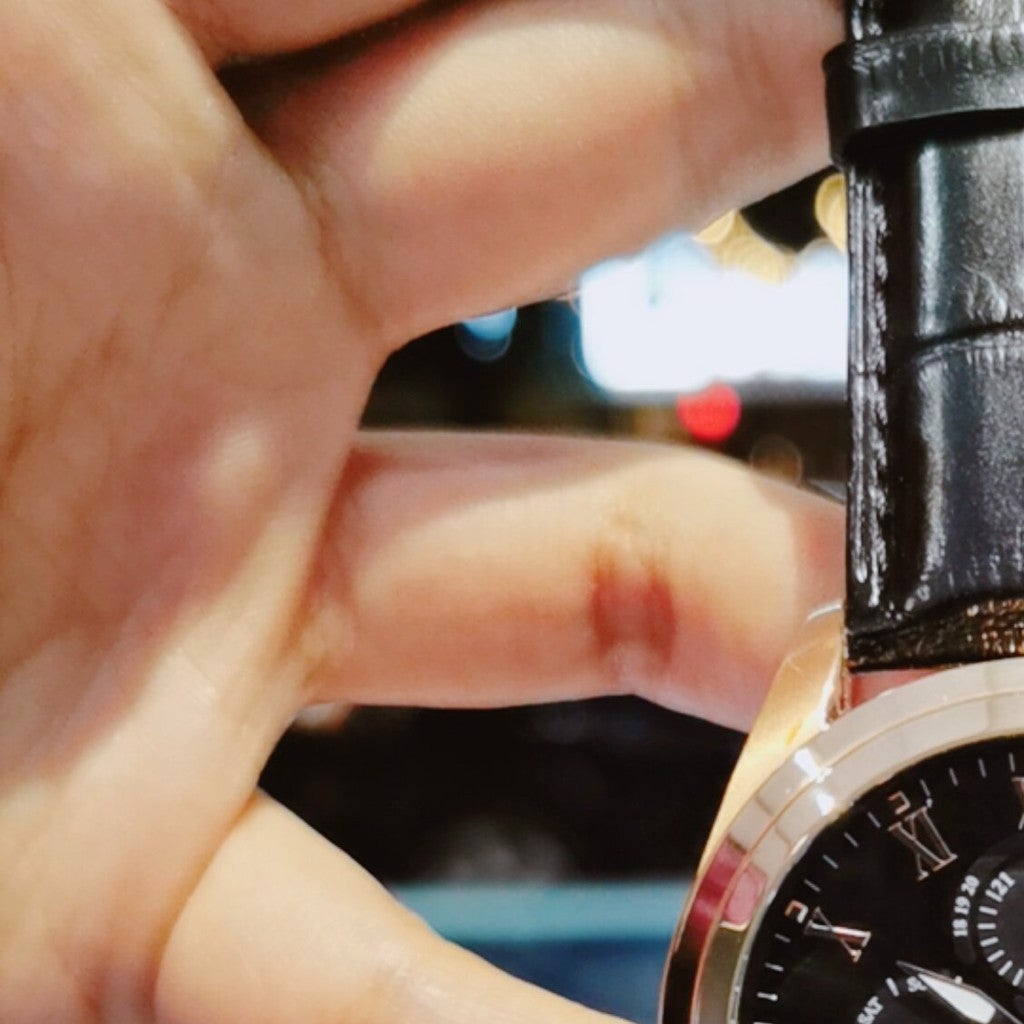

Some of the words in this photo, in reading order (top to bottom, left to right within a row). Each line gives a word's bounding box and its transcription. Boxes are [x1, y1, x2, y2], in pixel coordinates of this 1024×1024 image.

[888, 806, 958, 881] XI
[961, 875, 980, 896] 20
[954, 896, 971, 915] 19
[804, 906, 872, 963] X
[952, 918, 968, 937] 18
